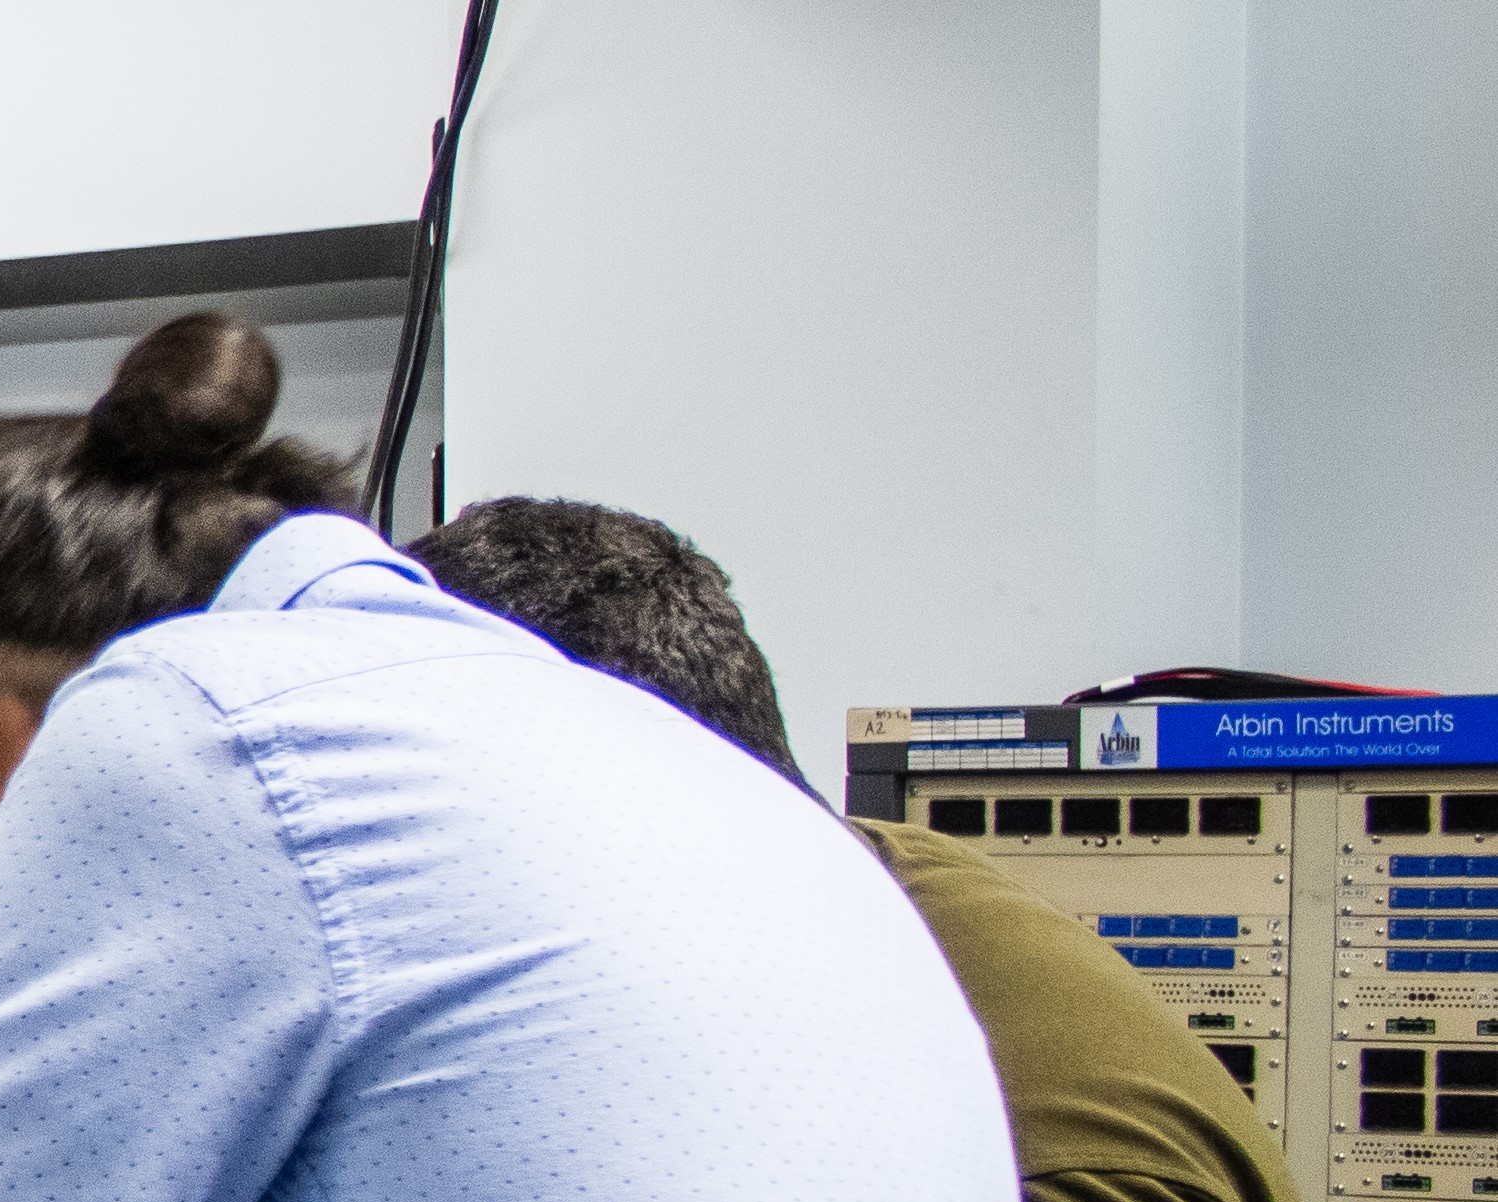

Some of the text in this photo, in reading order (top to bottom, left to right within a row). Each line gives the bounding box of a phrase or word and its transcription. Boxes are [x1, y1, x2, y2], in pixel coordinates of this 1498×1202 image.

[864, 720, 886, 737] A2
[1215, 709, 1454, 737] Arbin Instruments
[1242, 746, 1272, 758] Total
[1276, 744, 1330, 757] Solution
[1334, 743, 1358, 756] The
[1362, 742, 1401, 756] World
[1405, 742, 1440, 755] Over
